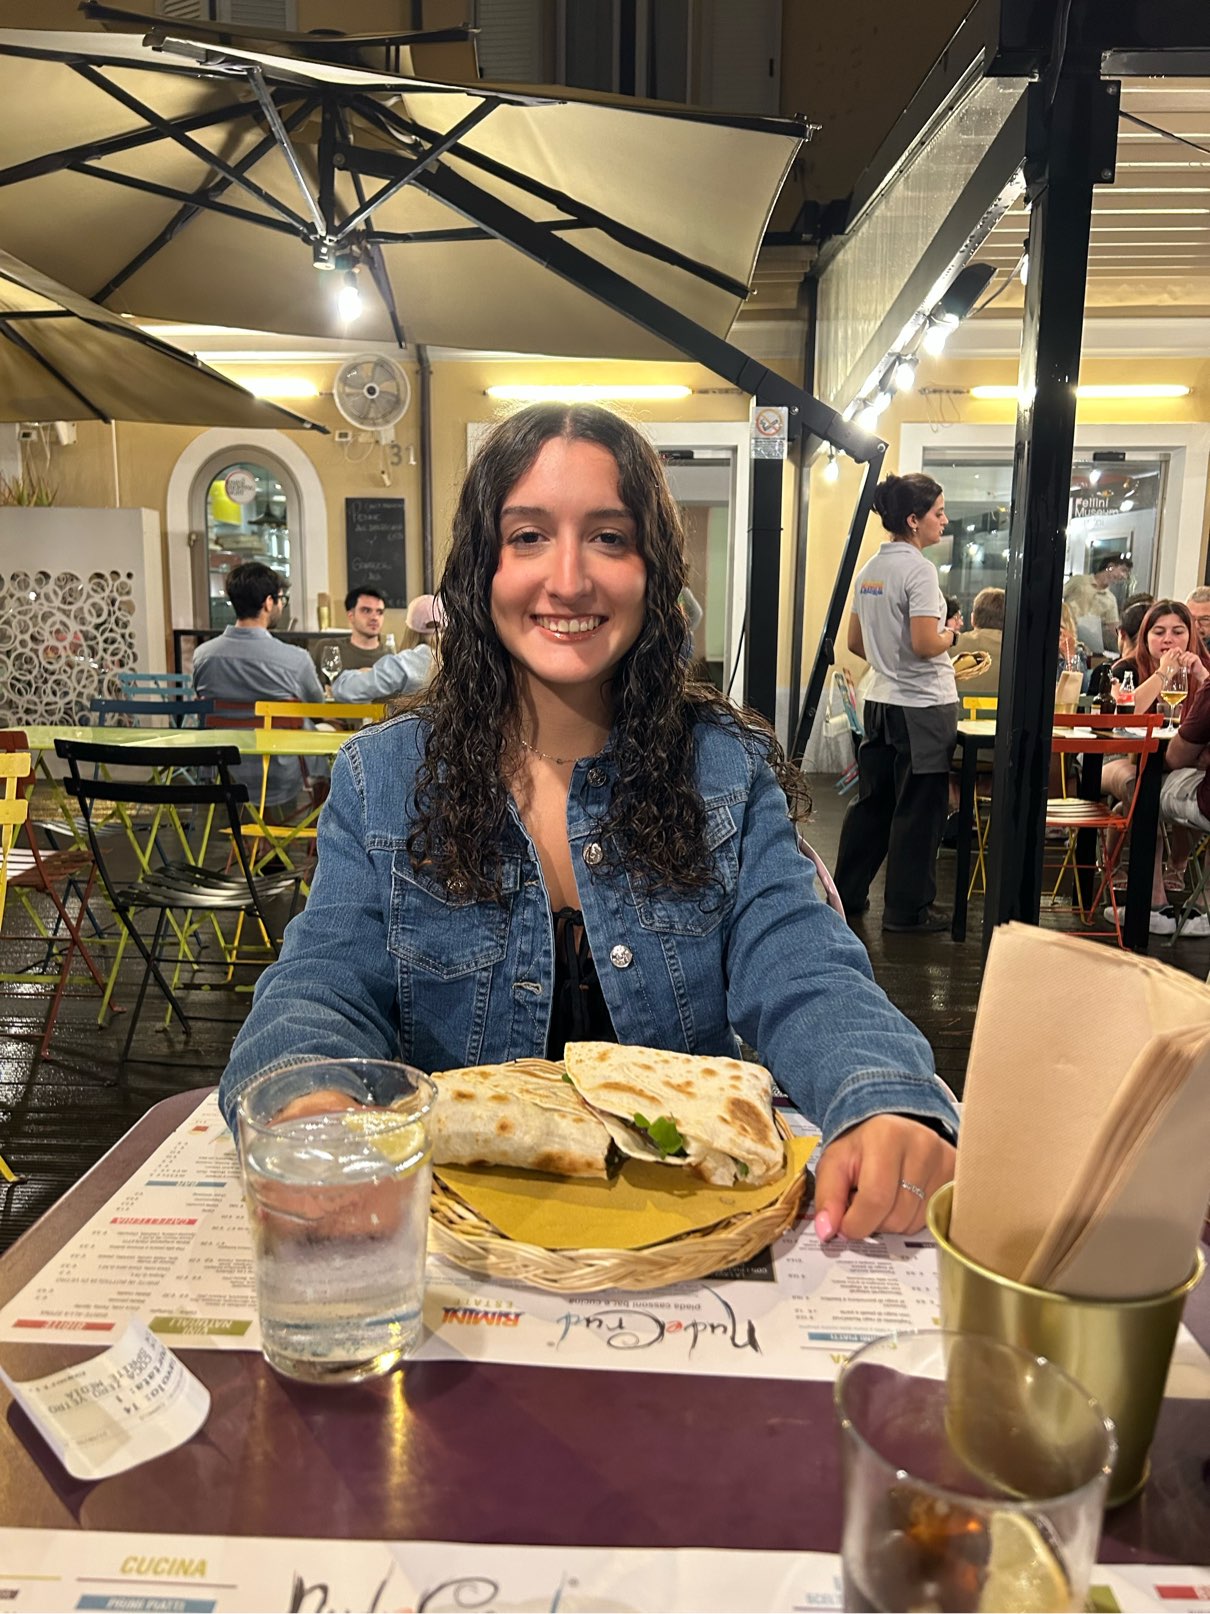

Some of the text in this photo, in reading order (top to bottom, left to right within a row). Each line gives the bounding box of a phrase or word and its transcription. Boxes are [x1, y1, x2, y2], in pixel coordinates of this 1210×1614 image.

[568, 1298, 602, 1308] cucina
[632, 1301, 671, 1310] cassoni
[673, 1302, 702, 1312] piada
[441, 1308, 521, 1328] RIMINI
[119, 1555, 209, 1578] CUCINA
